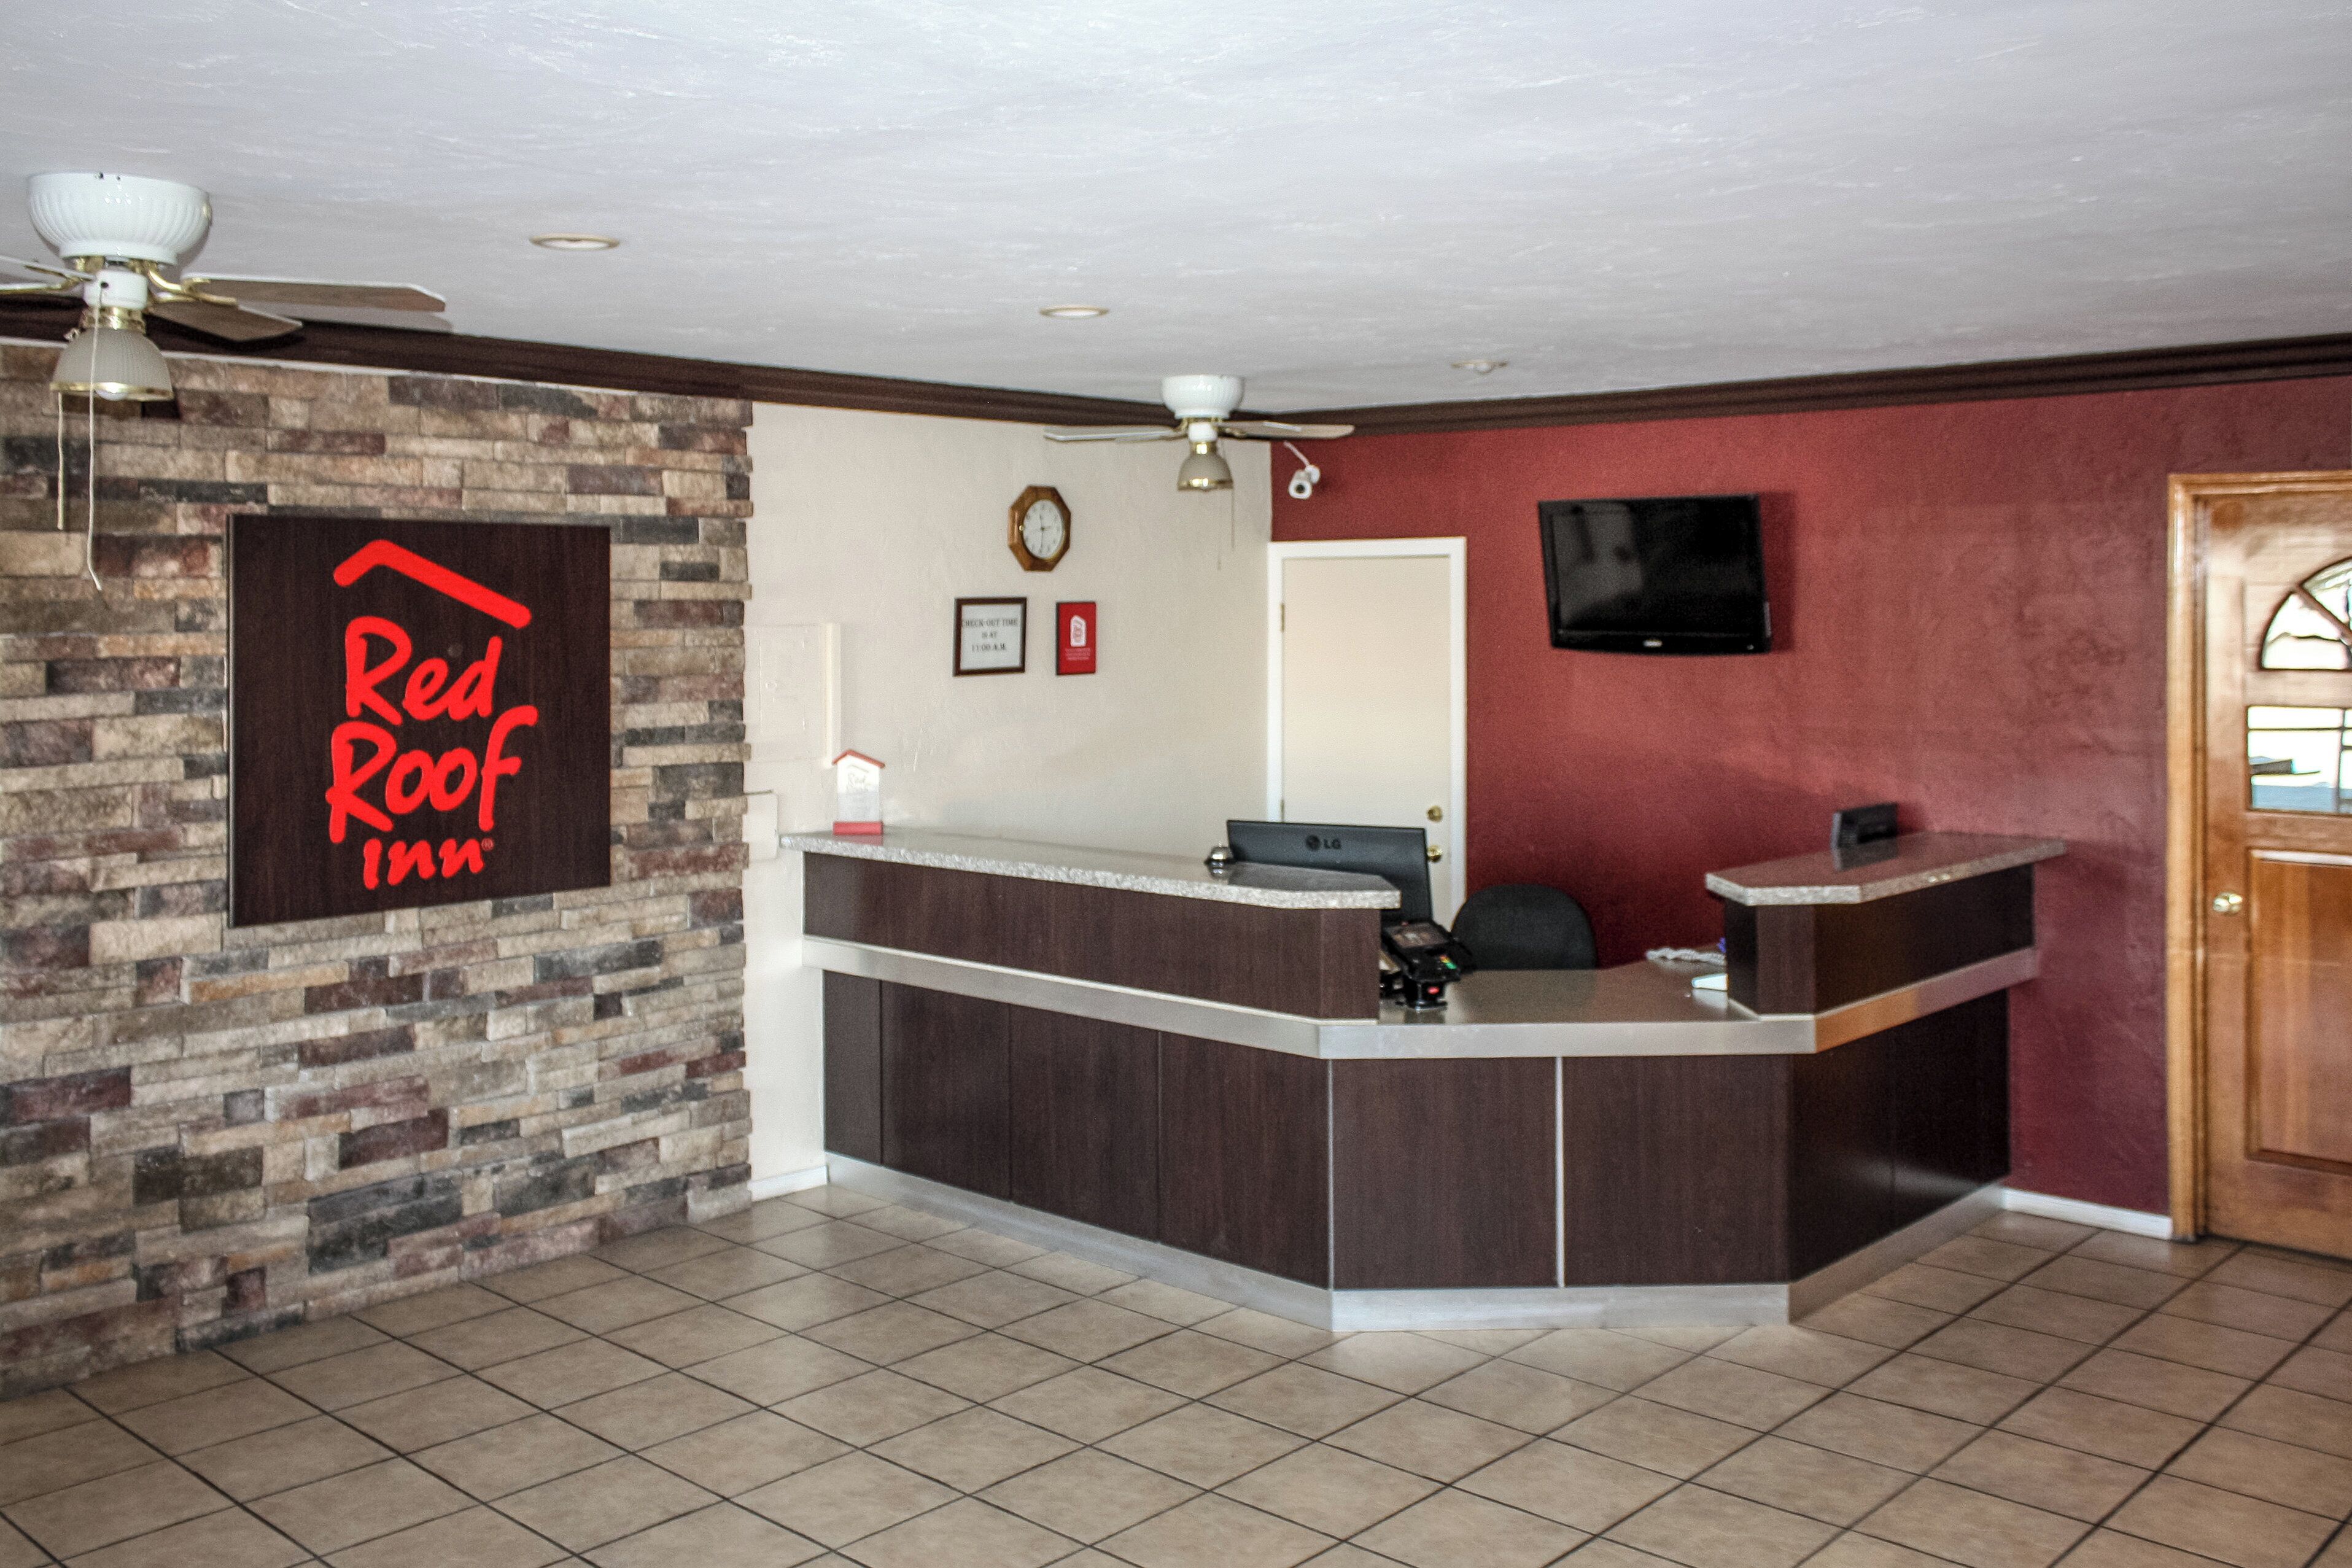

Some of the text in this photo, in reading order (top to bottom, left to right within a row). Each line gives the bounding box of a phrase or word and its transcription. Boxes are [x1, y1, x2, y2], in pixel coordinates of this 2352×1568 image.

[1002, 618, 1018, 626] TIME
[344, 616, 503, 726] Red
[325, 705, 539, 844] Roof
[1324, 839, 1341, 850] LG
